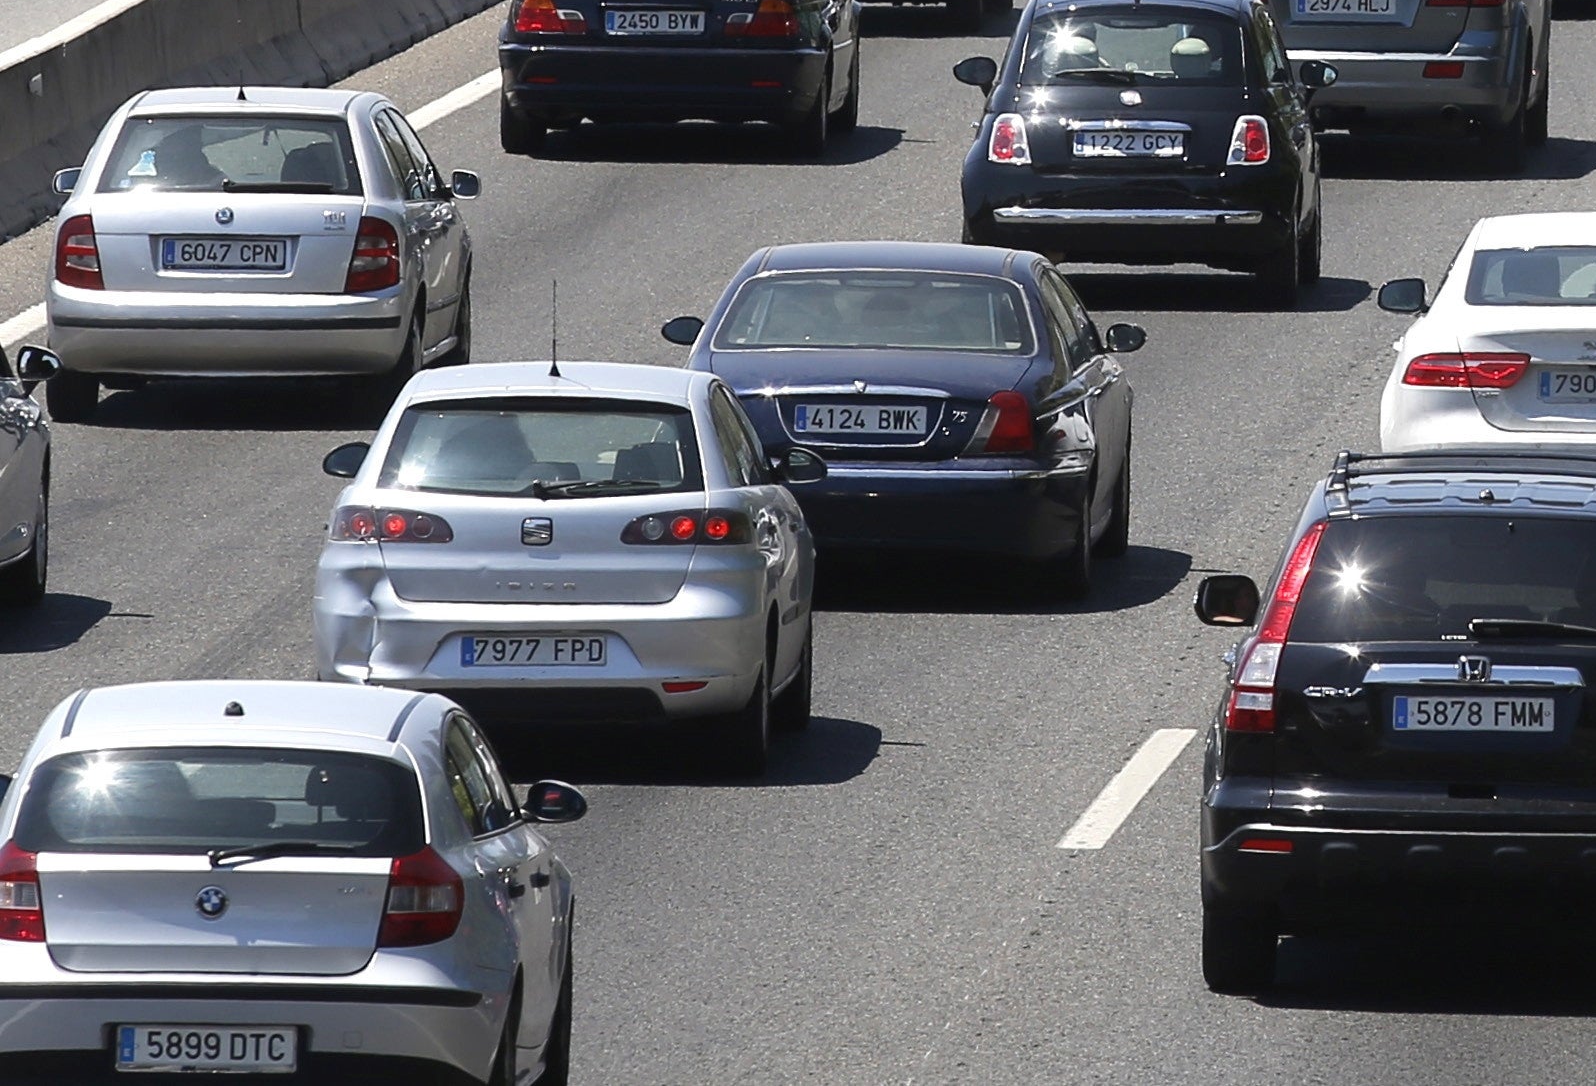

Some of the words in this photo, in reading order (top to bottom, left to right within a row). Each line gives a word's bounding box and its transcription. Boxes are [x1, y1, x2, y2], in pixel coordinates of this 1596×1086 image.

[617, 14, 659, 30] 2450
[668, 14, 699, 30] BYW
[1090, 134, 1135, 151] 1222
[1142, 134, 1178, 151] GCY
[181, 243, 231, 263] 6047
[240, 244, 278, 264] CPN
[811, 409, 865, 430] 4124
[879, 409, 919, 431] BWK
[474, 638, 540, 661] 7977
[554, 638, 603, 661] FPD
[1416, 701, 1482, 726] 5878
[1494, 701, 1544, 727] FMM
[147, 1031, 220, 1060] 5899
[230, 1032, 286, 1061] DTC
